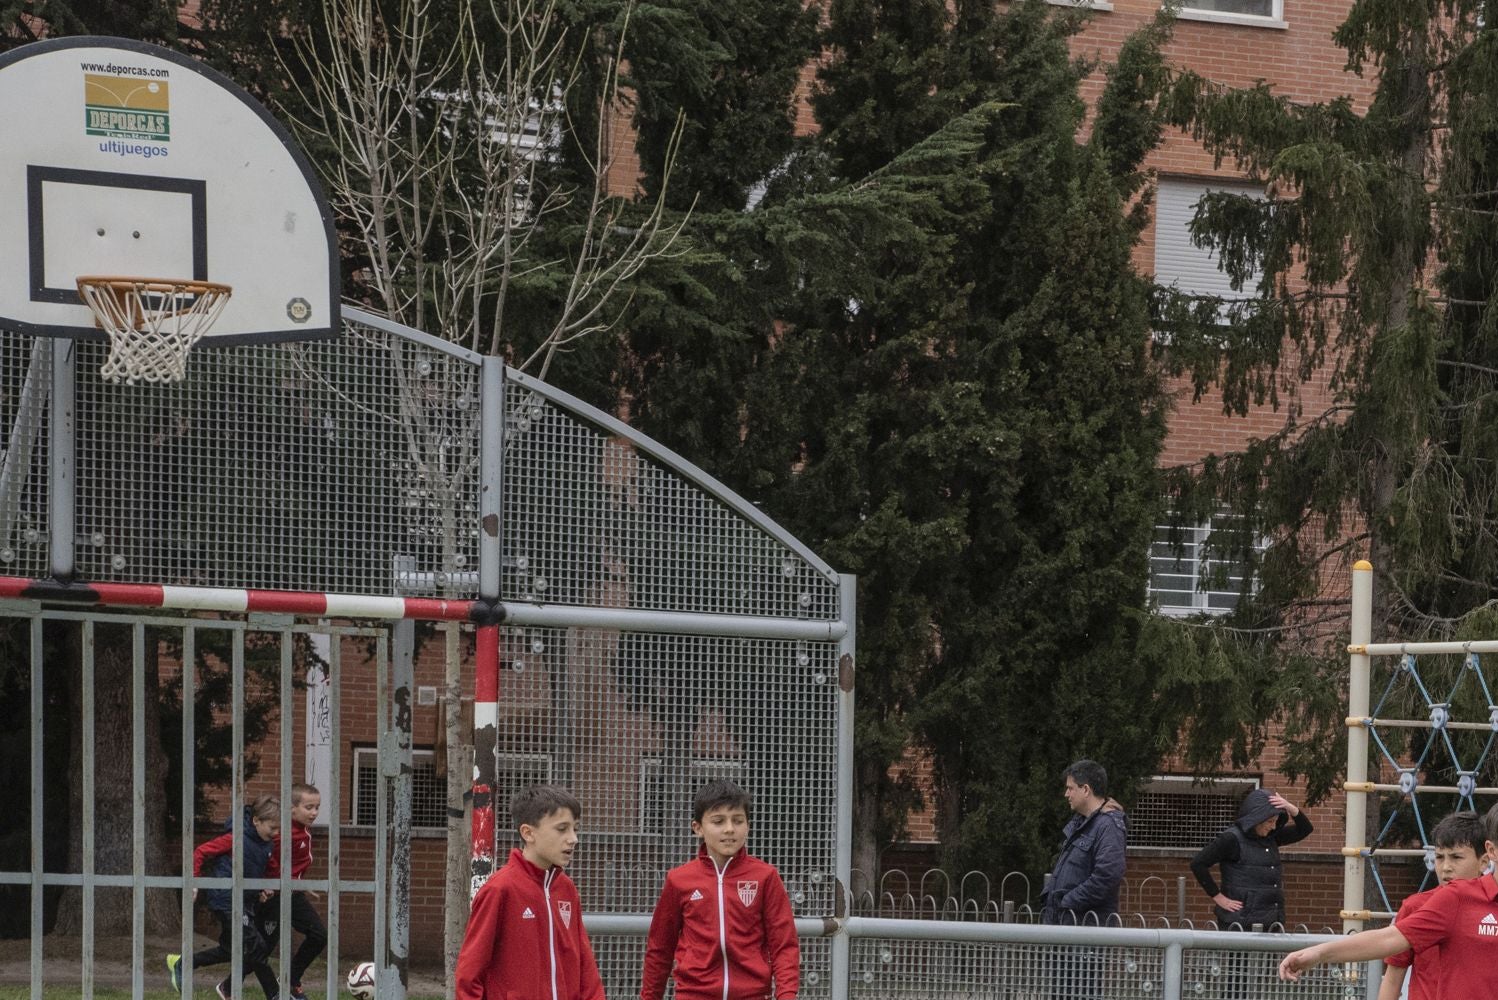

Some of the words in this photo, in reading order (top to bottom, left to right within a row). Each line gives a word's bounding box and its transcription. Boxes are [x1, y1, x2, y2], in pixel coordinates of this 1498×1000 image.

[81, 62, 169, 77] www.deporcas.com
[90, 110, 165, 133] DEPORCAS
[99, 141, 168, 158] ultijuegos
